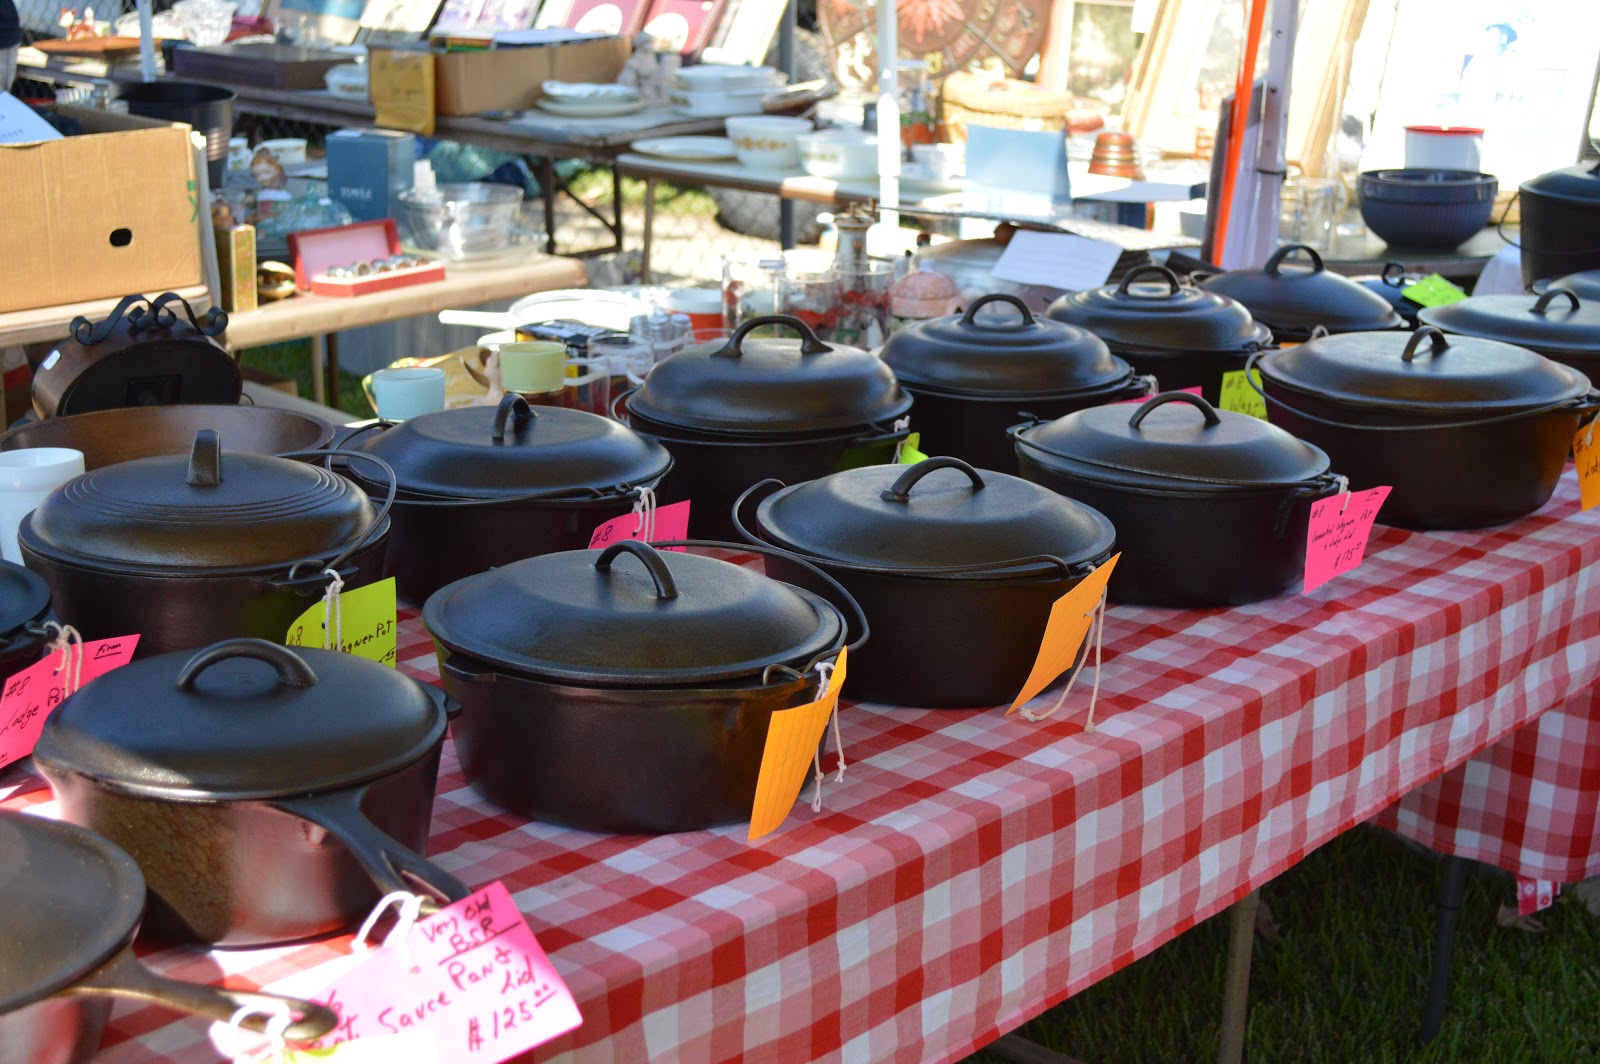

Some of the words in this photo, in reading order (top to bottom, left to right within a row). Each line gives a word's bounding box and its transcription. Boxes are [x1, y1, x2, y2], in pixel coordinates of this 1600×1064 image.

[591, 524, 614, 546] #8
[4, 675, 31, 702] #8
[420, 916, 459, 943] Very
